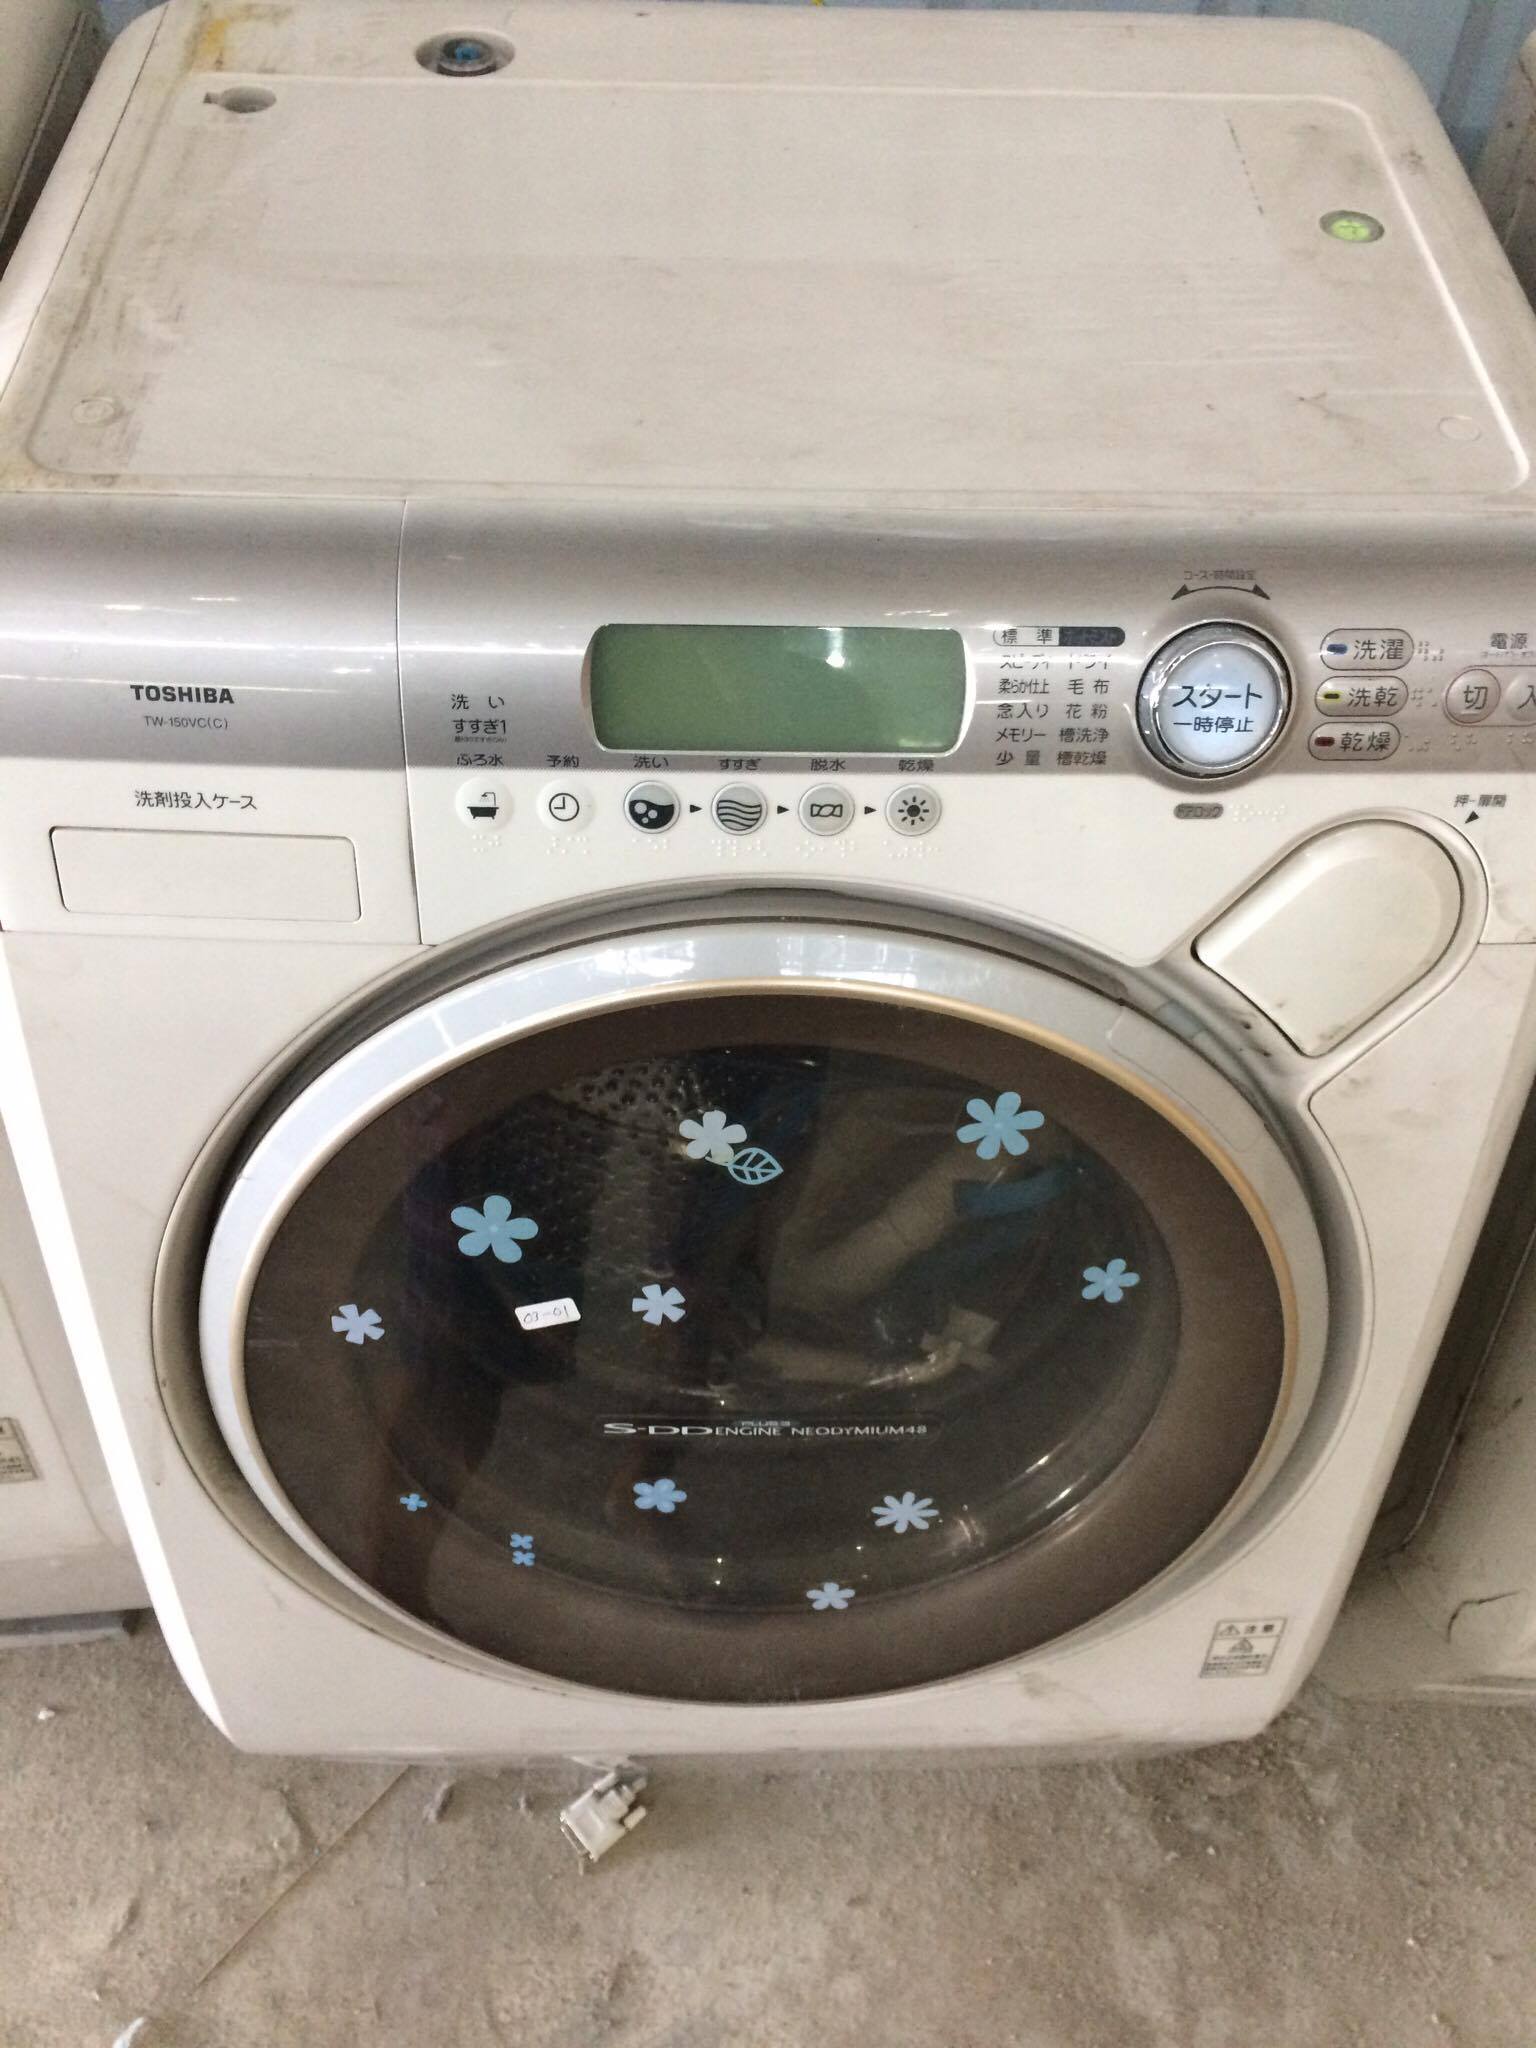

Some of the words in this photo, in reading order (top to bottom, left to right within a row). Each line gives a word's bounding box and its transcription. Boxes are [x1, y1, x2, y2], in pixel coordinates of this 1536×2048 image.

[1001, 628, 1053, 644] 標準
[1490, 632, 1528, 650] 電源
[1352, 638, 1404, 660] 洗濯
[129, 684, 235, 704] TOSHIBA
[1067, 678, 1110, 695] 毛布
[451, 693, 505, 710] 洗い
[1172, 683, 1263, 709] スタート
[1347, 685, 1399, 708] 洗乾
[1463, 684, 1488, 710] 切
[997, 702, 1049, 719] 念入り
[1065, 703, 1109, 719] 花粉
[144, 715, 229, 729] TW-150VC(C)
[452, 718, 507, 735] すすぎ1
[1172, 717, 1254, 733] 一時停止
[995, 728, 1047, 743] メモリー
[1058, 728, 1110, 744] 槽洗浄
[1339, 731, 1392, 752] 乾燥
[456, 753, 504, 767] ふろ水
[546, 755, 580, 769] 予約
[633, 756, 669, 769] 洗い
[719, 758, 761, 771] すすぎ
[810, 758, 846, 772] 脱水
[898, 759, 934, 773] 乾燥
[995, 750, 1041, 766] 少量
[134, 790, 258, 810] 洗剤投入ケース
[603, 1422, 713, 1436] S-DD
[715, 1426, 781, 1436] ENGINE
[791, 1425, 928, 1436] NEODYMIUM48
